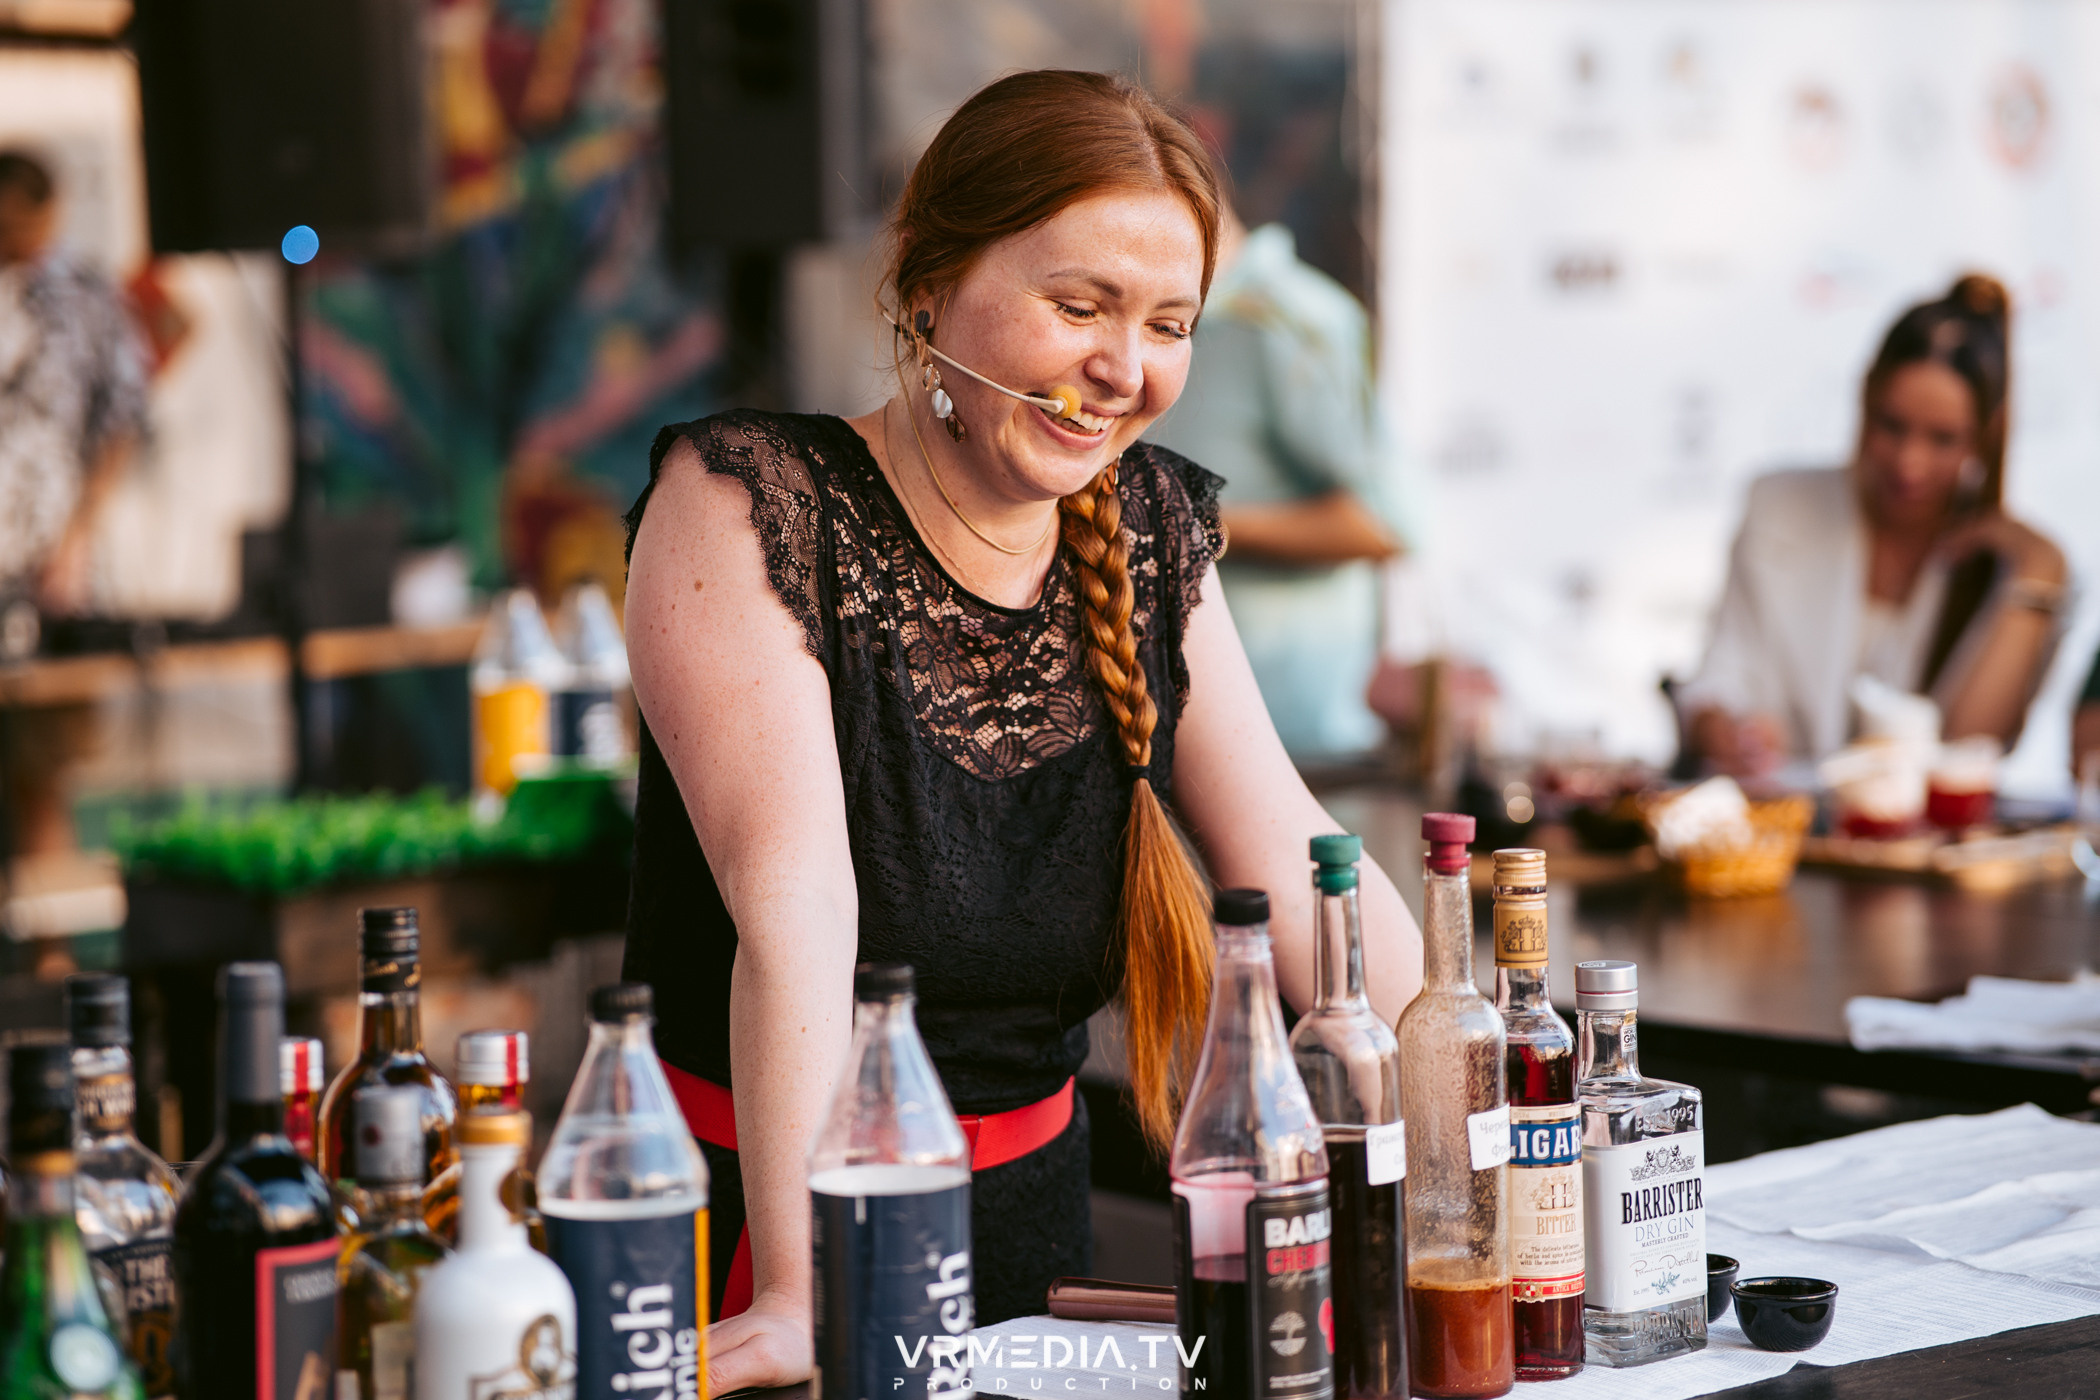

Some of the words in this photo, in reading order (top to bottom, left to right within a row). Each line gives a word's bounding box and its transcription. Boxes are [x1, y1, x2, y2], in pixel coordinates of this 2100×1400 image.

[1666, 1103, 1695, 1126] 1995
[1620, 1177, 1704, 1225] BARRISTER
[1536, 1213, 1577, 1236] BITTER
[1635, 1221, 1663, 1242] DRY
[1667, 1214, 1695, 1235] GIN
[1641, 1237, 1667, 1248] MASTERLY
[1667, 1232, 1689, 1243] CRAFTED
